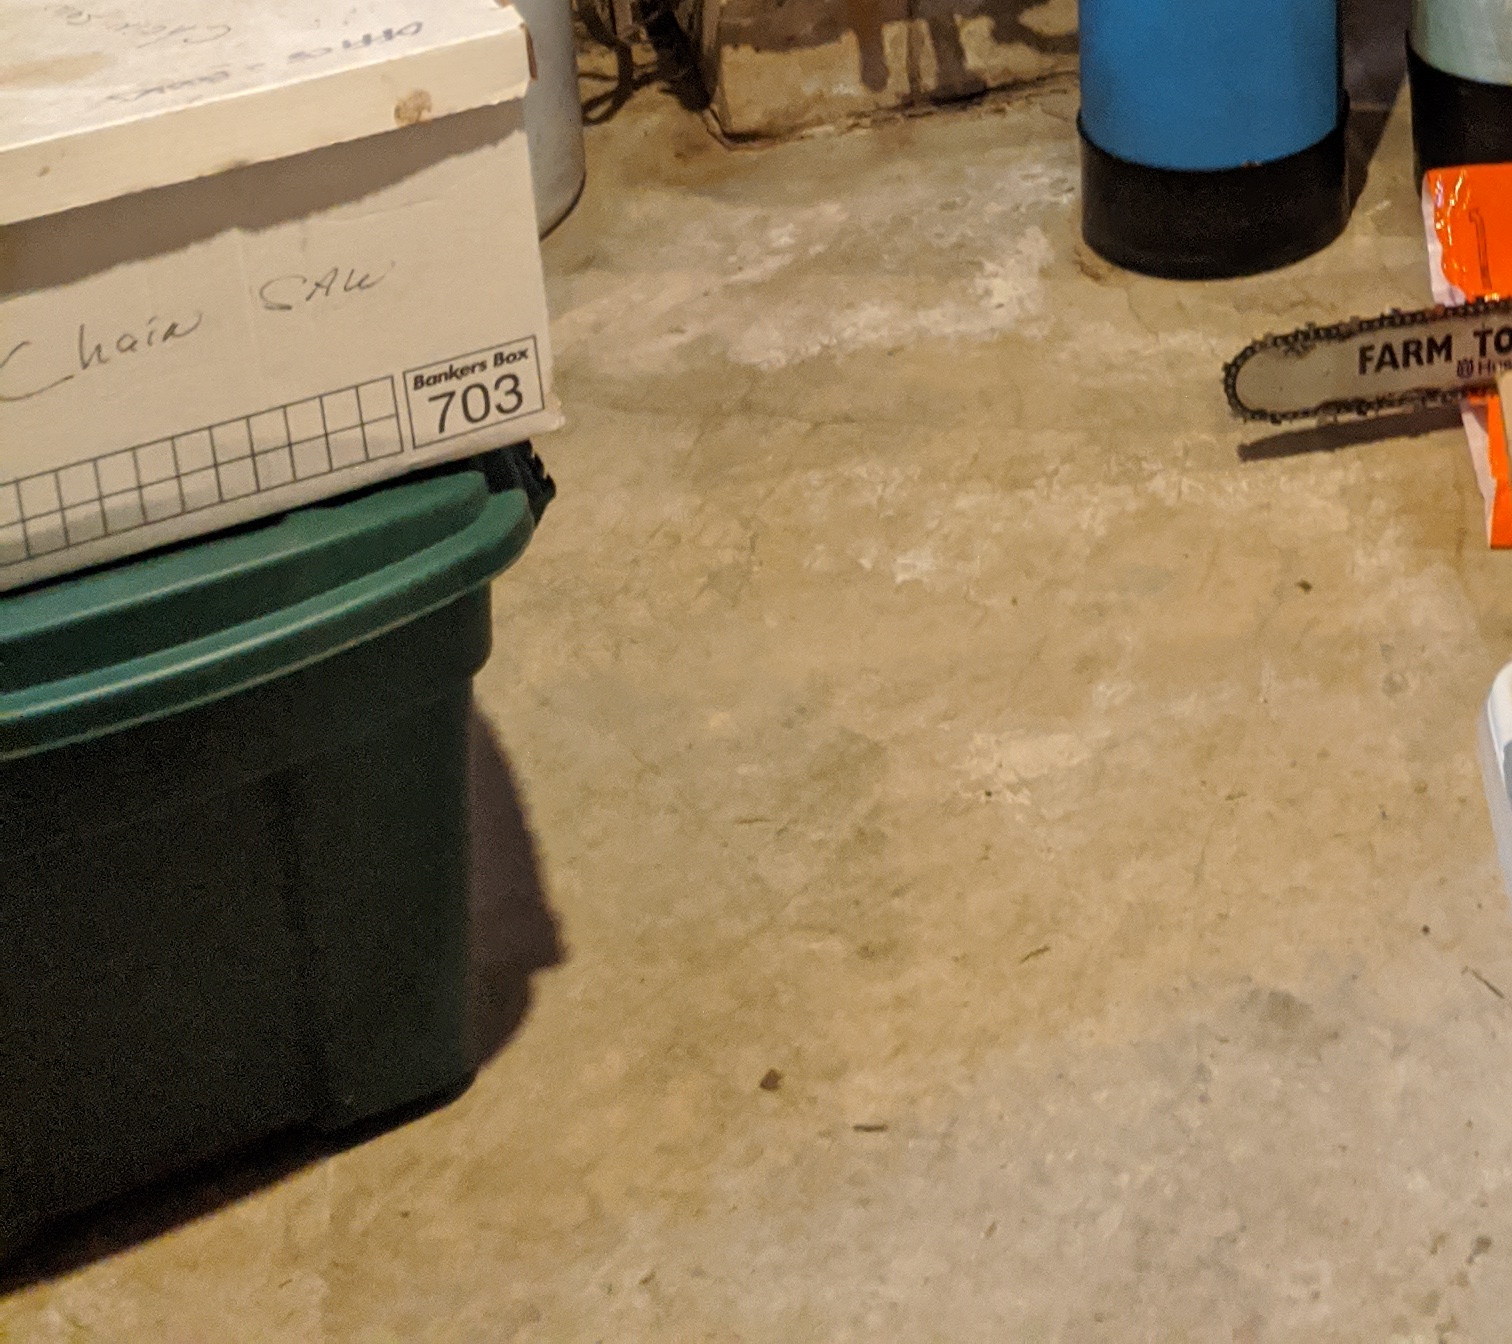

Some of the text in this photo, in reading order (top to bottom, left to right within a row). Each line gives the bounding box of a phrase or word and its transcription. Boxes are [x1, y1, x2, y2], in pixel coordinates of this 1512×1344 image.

[413, 348, 529, 391] Bankers Box
[1358, 333, 1453, 376] FARM
[428, 373, 524, 434] 703
